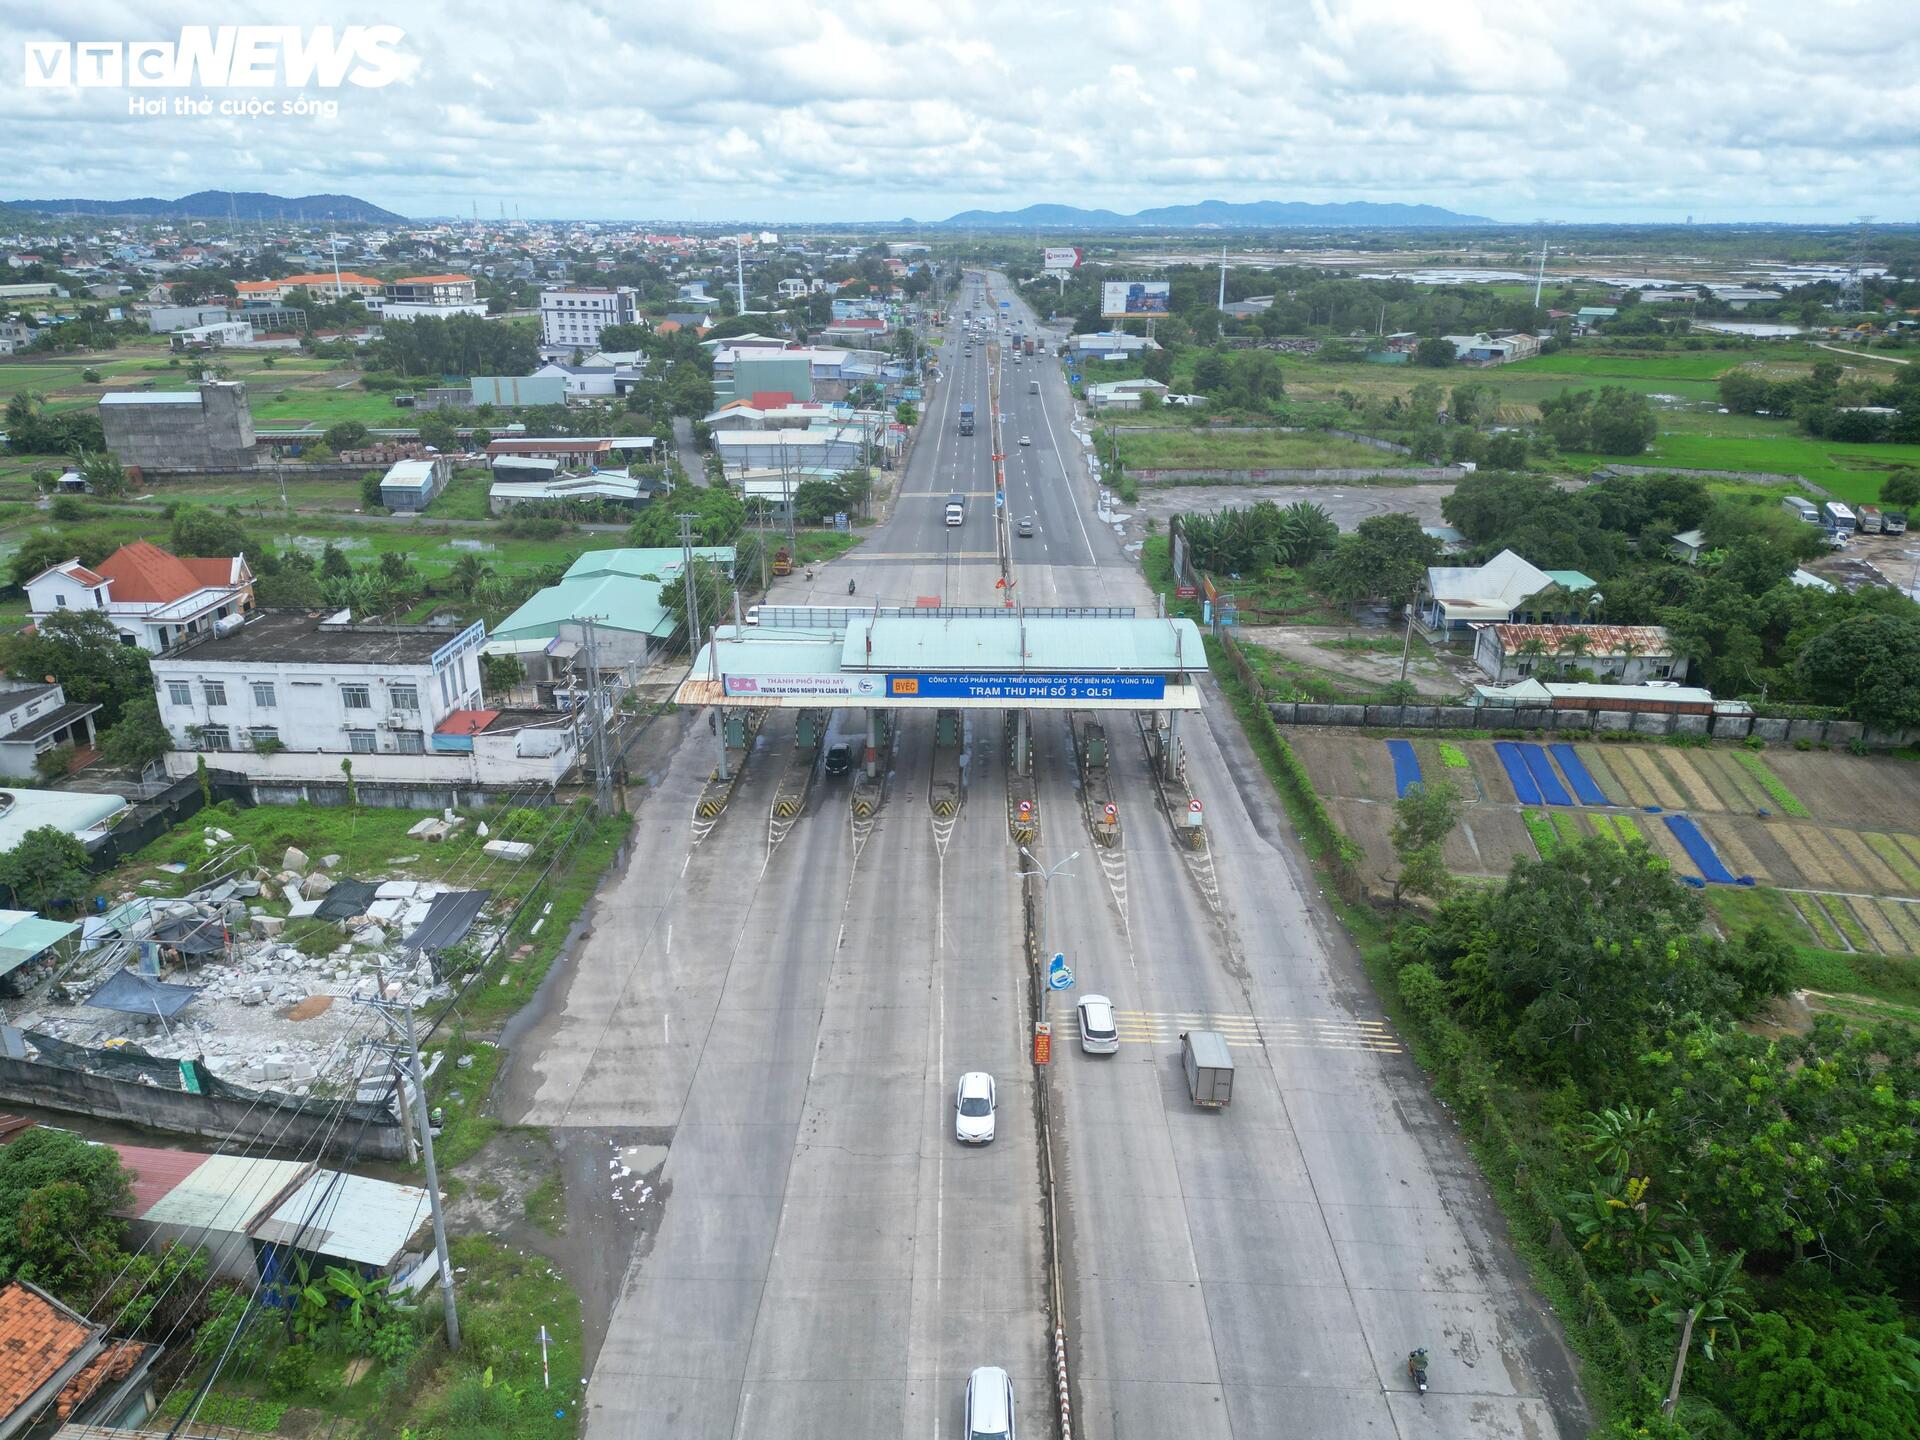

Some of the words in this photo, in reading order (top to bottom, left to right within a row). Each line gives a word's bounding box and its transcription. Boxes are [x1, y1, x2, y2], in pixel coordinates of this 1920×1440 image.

[796, 676, 813, 684] PHỐ
[928, 675, 947, 683] CÔNG
[959, 675, 969, 683] CỔ
[970, 674, 988, 683] PHẦN
[989, 674, 1006, 683] PHÁT
[1008, 674, 1028, 684] TRIỂN
[1028, 675, 1052, 684] ĐƯỜNG
[1053, 676, 1068, 684] CAO
[1069, 674, 1083, 684] TỐC
[1084, 675, 1100, 684] BIÊN
[1120, 675, 1139, 684] VŨNG
[1141, 675, 1155, 684] TÀU
[895, 682, 915, 692] BVEC
[969, 687, 1000, 697] TRẠM
[1004, 687, 1026, 695] THU
[1029, 686, 1047, 696] PHÍ
[1050, 684, 1066, 696] SỐ
[1071, 687, 1077, 696] 3
[1087, 687, 1112, 697] QL51
